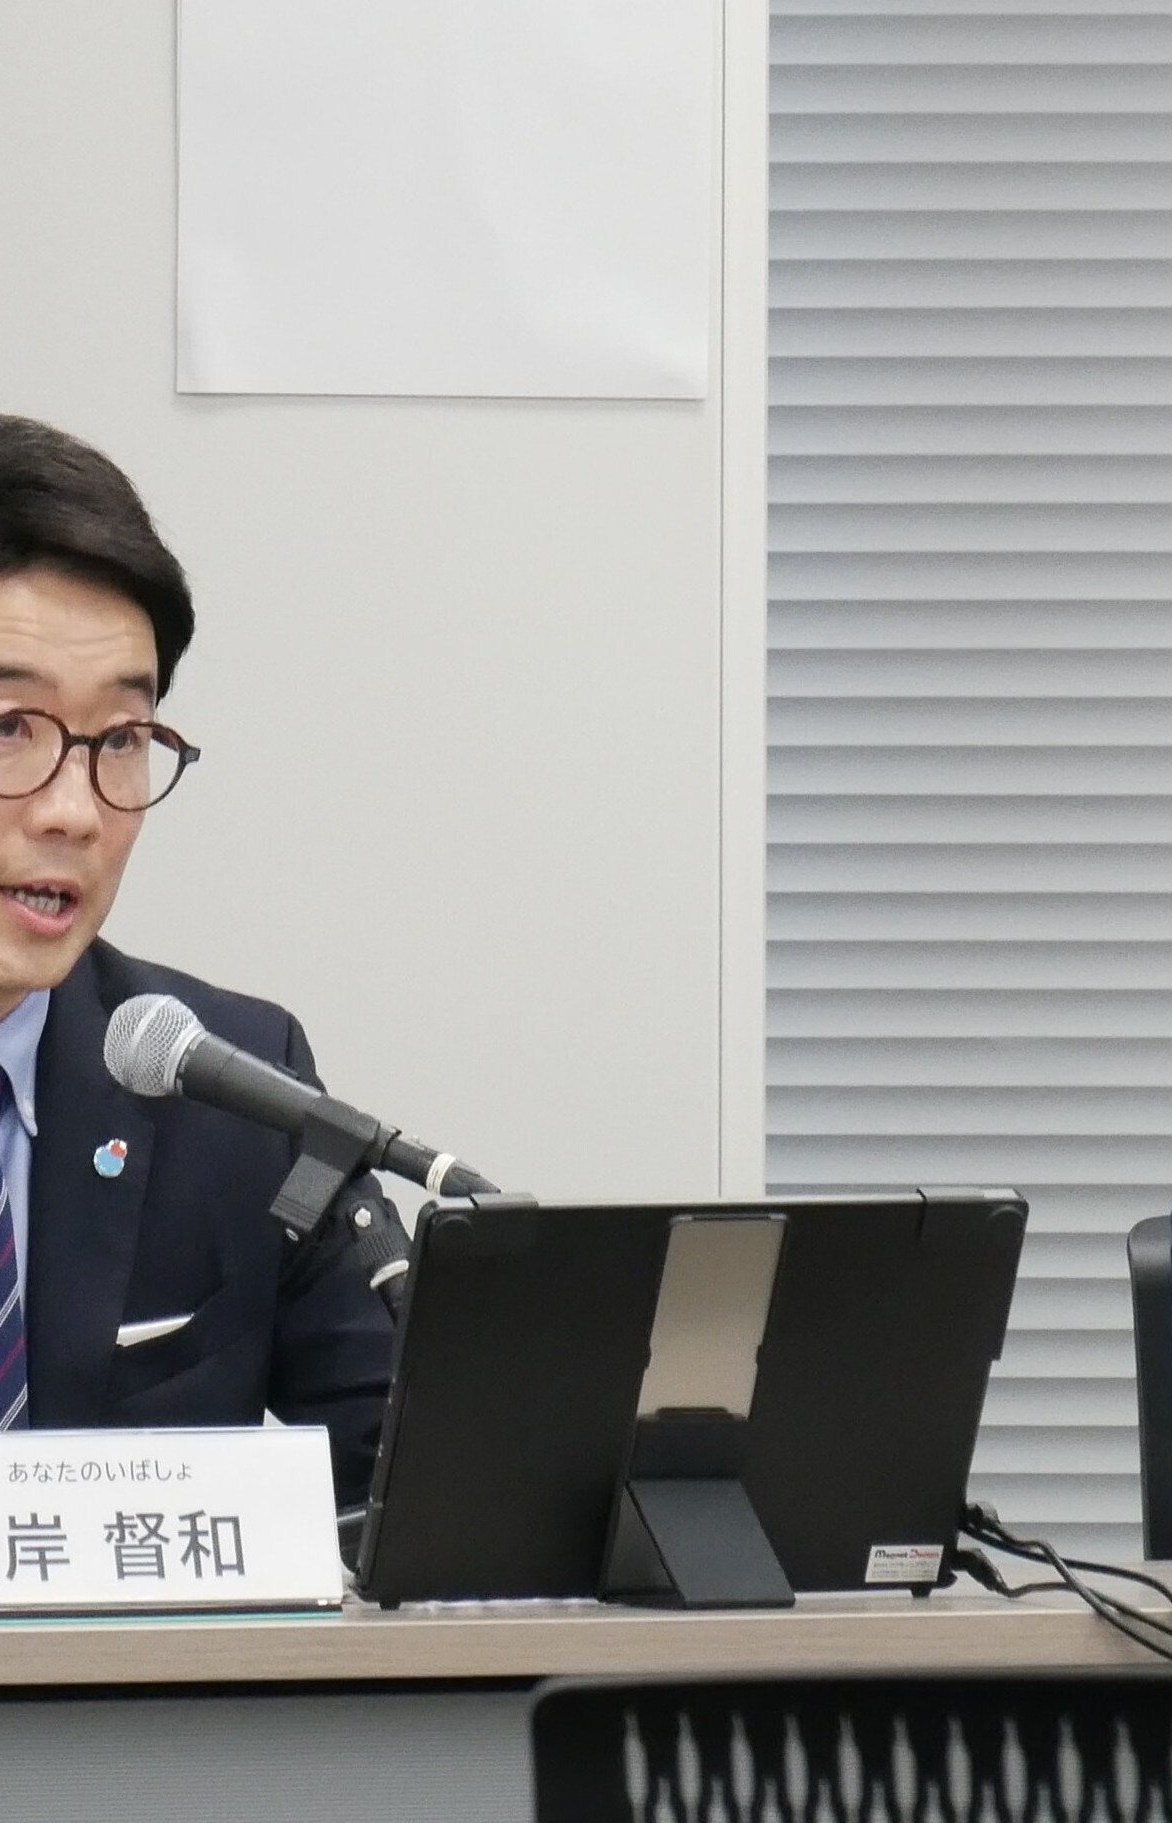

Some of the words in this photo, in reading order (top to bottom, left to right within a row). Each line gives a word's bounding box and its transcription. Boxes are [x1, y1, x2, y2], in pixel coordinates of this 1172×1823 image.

[9, 1459, 192, 1483] あなたのいばしょ
[104, 1510, 246, 1580] 督和
